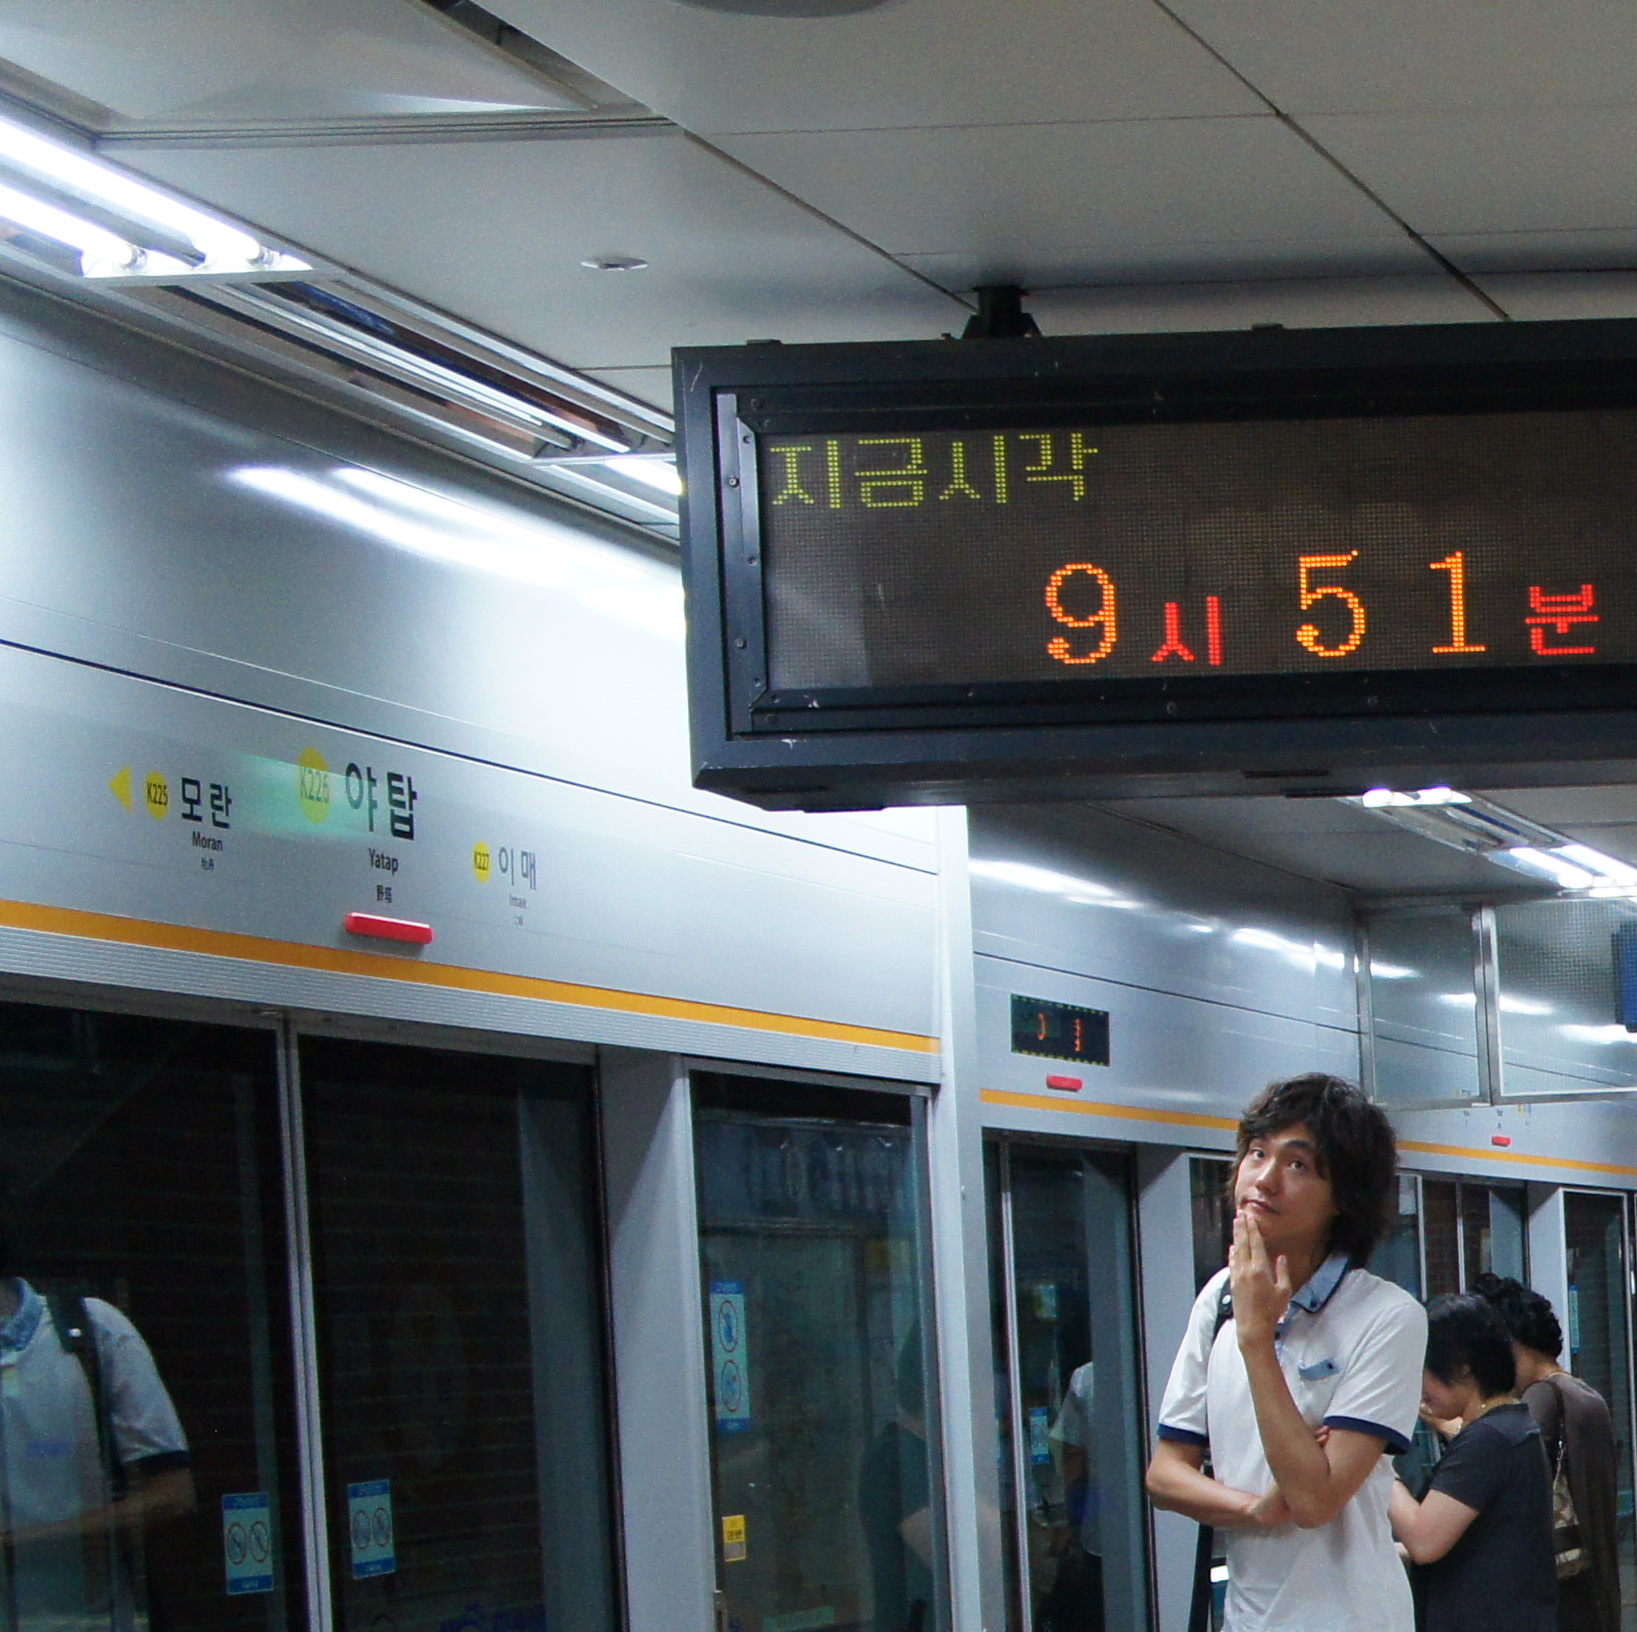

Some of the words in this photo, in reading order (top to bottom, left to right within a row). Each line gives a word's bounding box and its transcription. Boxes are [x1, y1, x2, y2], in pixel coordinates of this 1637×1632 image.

[769, 432, 1099, 510] 지금시각
[146, 780, 169, 807] K225
[180, 776, 234, 829] 모란
[299, 764, 331, 807] K226
[344, 761, 419, 841] 야탑
[192, 830, 224, 852] Moran
[368, 847, 400, 877] Yatap
[497, 845, 538, 891] 이매
